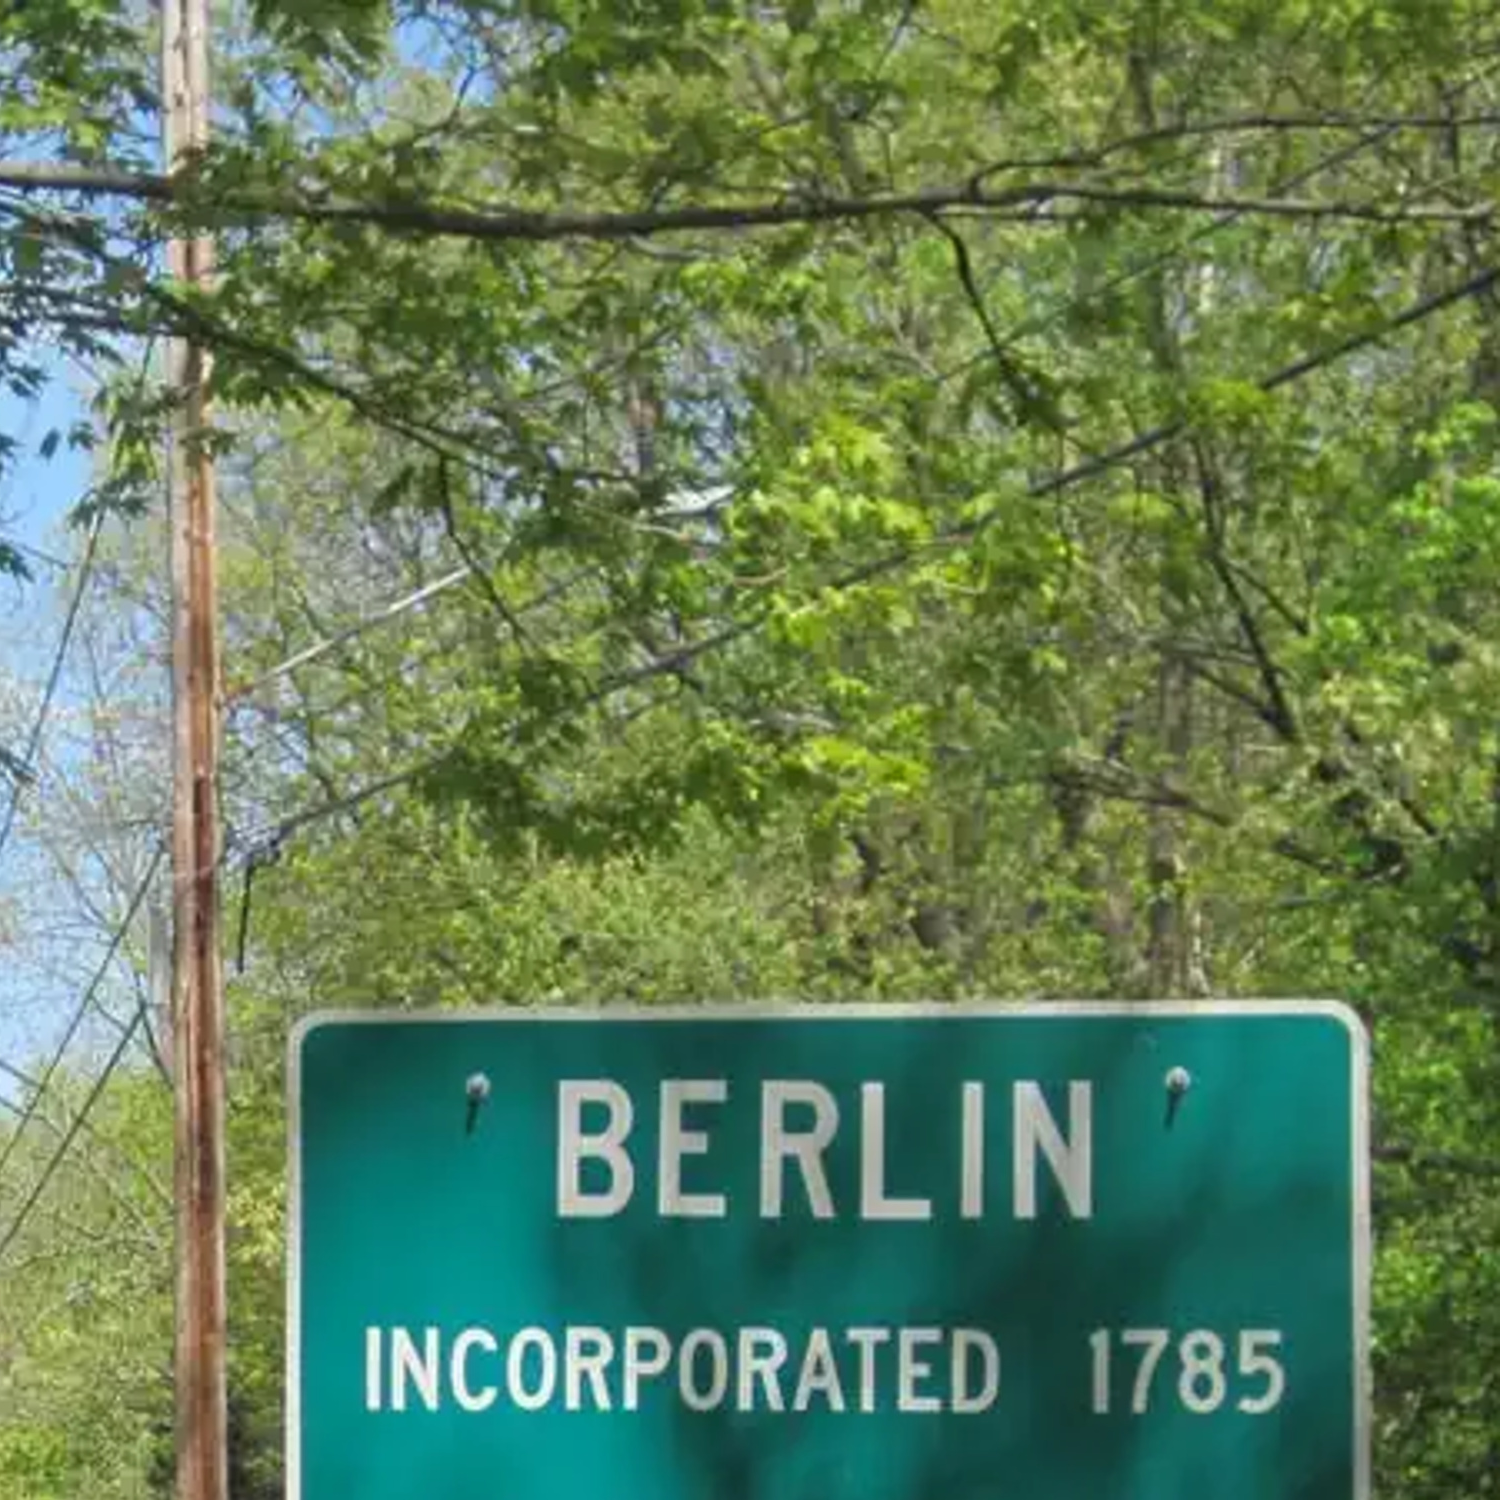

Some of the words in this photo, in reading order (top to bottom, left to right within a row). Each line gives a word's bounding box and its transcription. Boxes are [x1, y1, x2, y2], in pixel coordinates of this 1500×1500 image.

[556, 1079, 1093, 1220] BERLIN
[364, 1325, 1000, 1413] INCORPORATED
[1090, 1328, 1286, 1414] 1785
